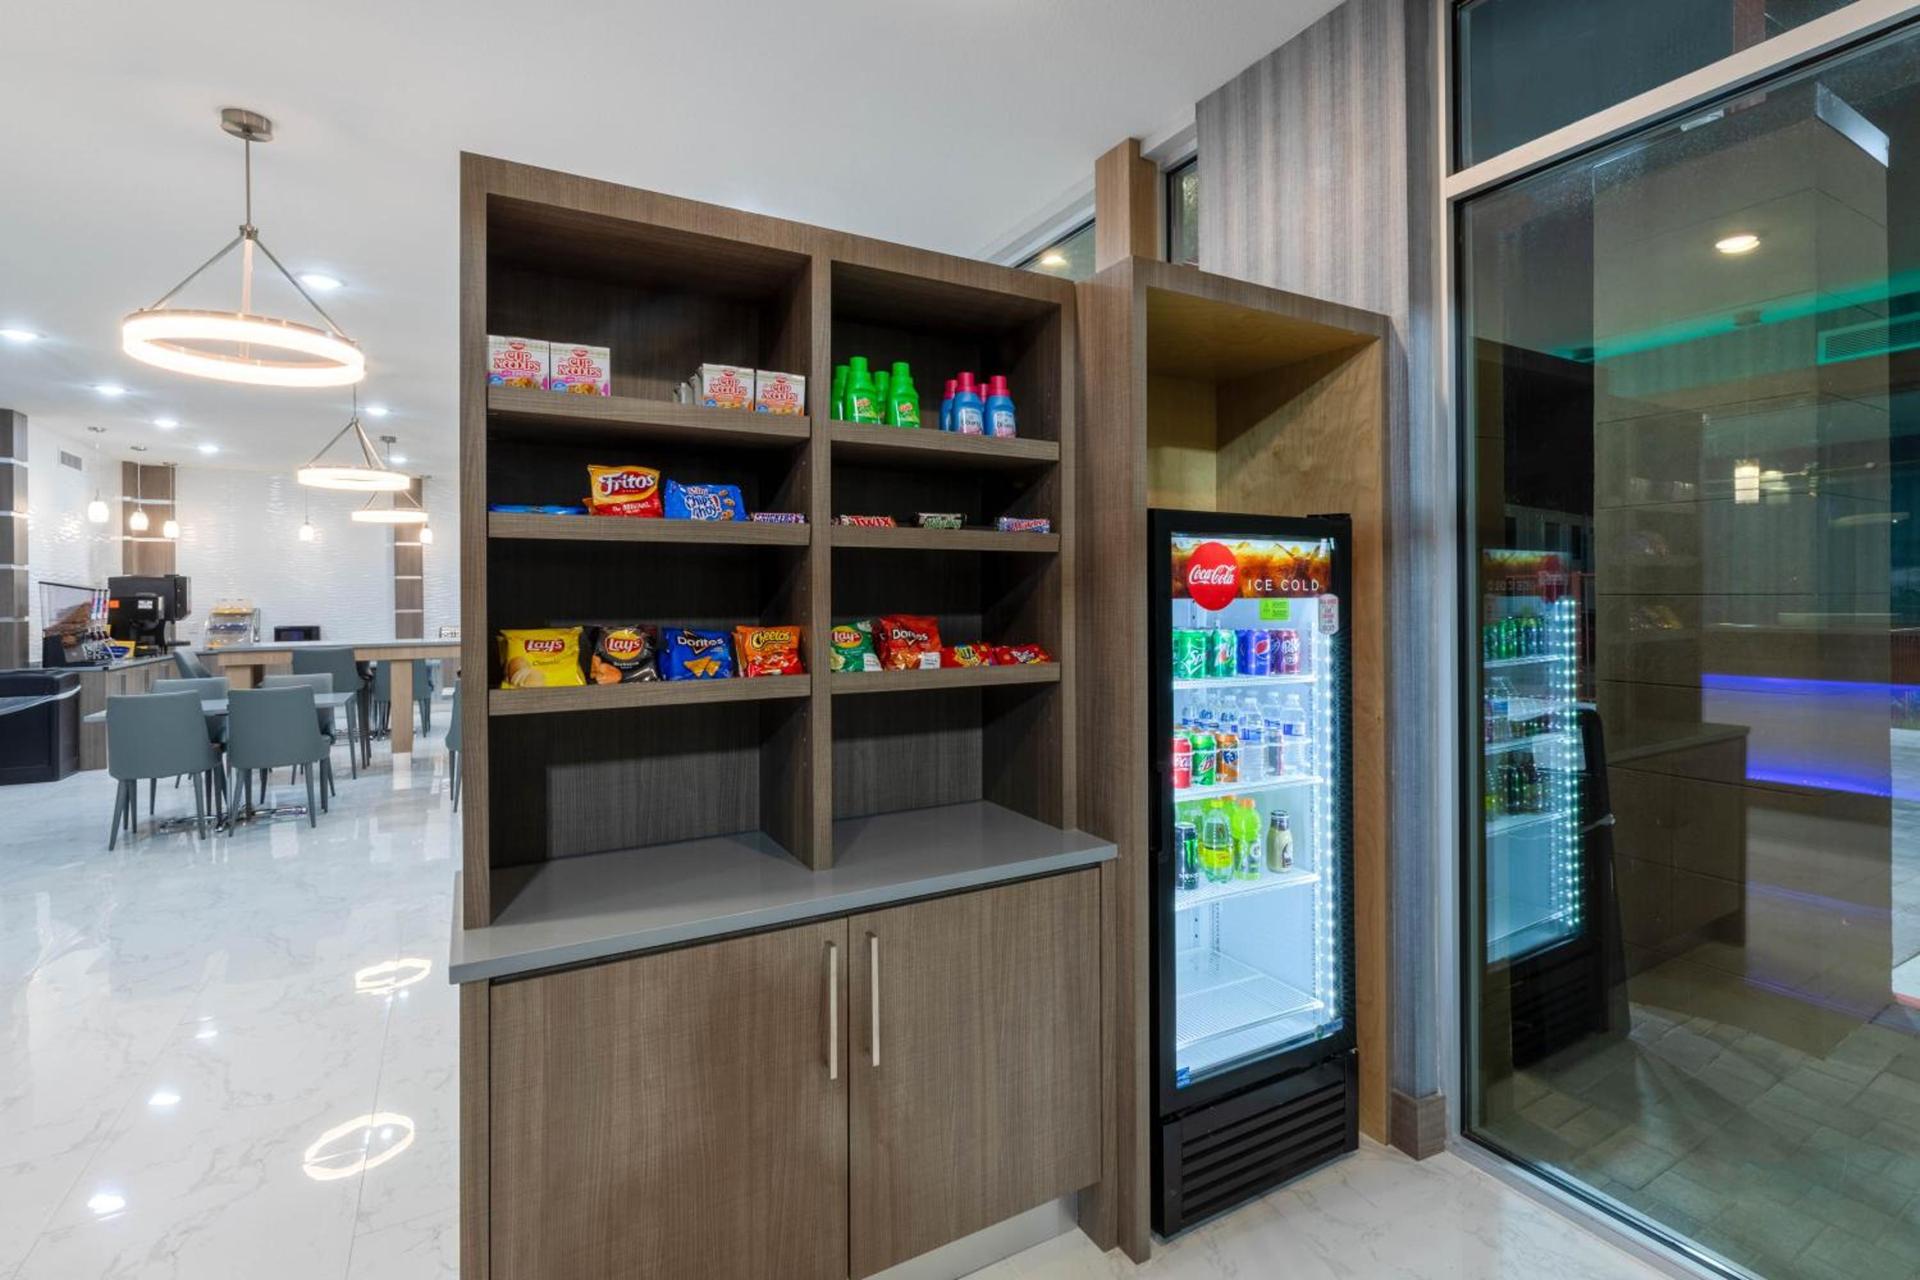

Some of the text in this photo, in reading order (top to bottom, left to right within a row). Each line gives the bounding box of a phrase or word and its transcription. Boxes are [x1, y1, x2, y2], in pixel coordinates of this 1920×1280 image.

[504, 350, 532, 361] CUP
[568, 357, 593, 367] CUP
[493, 358, 541, 372] NOODLES
[558, 364, 602, 378] NOODLES
[599, 472, 655, 496] Fritos
[1248, 579, 1320, 591] ICE COLD
[677, 635, 724, 647] Doritos
[751, 630, 791, 649] Cheetos
[893, 628, 928, 641] Doritos
